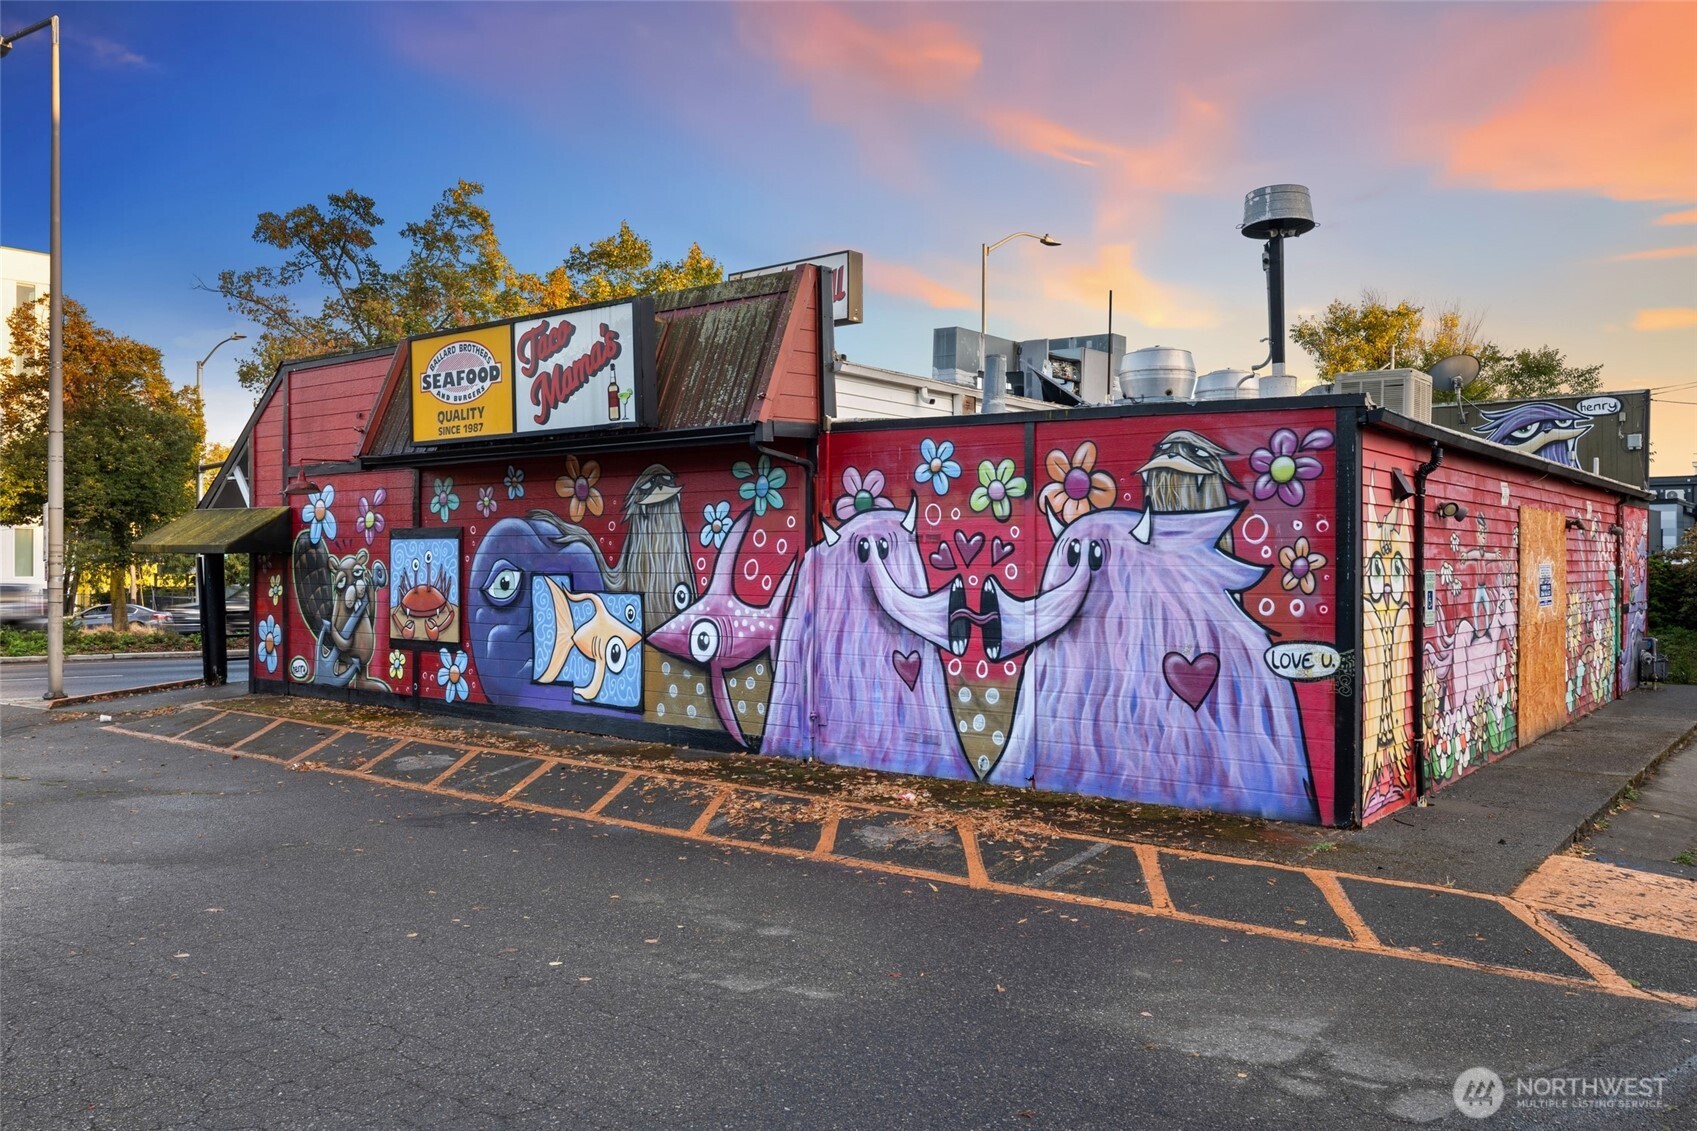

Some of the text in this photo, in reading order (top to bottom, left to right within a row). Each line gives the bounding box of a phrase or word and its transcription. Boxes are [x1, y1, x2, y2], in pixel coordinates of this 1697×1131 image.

[429, 343, 492, 372] BALLARD BROTHERS
[517, 320, 576, 378] Taco
[422, 365, 501, 391] SEAFOOD
[531, 323, 622, 425] Mama's
[436, 385, 485, 402] AND BURGERS
[437, 406, 485, 424] QUALITY
[1580, 402, 1617, 412] henry
[438, 422, 484, 436] SINCE 1987
[1272, 650, 1315, 669] LOVE
